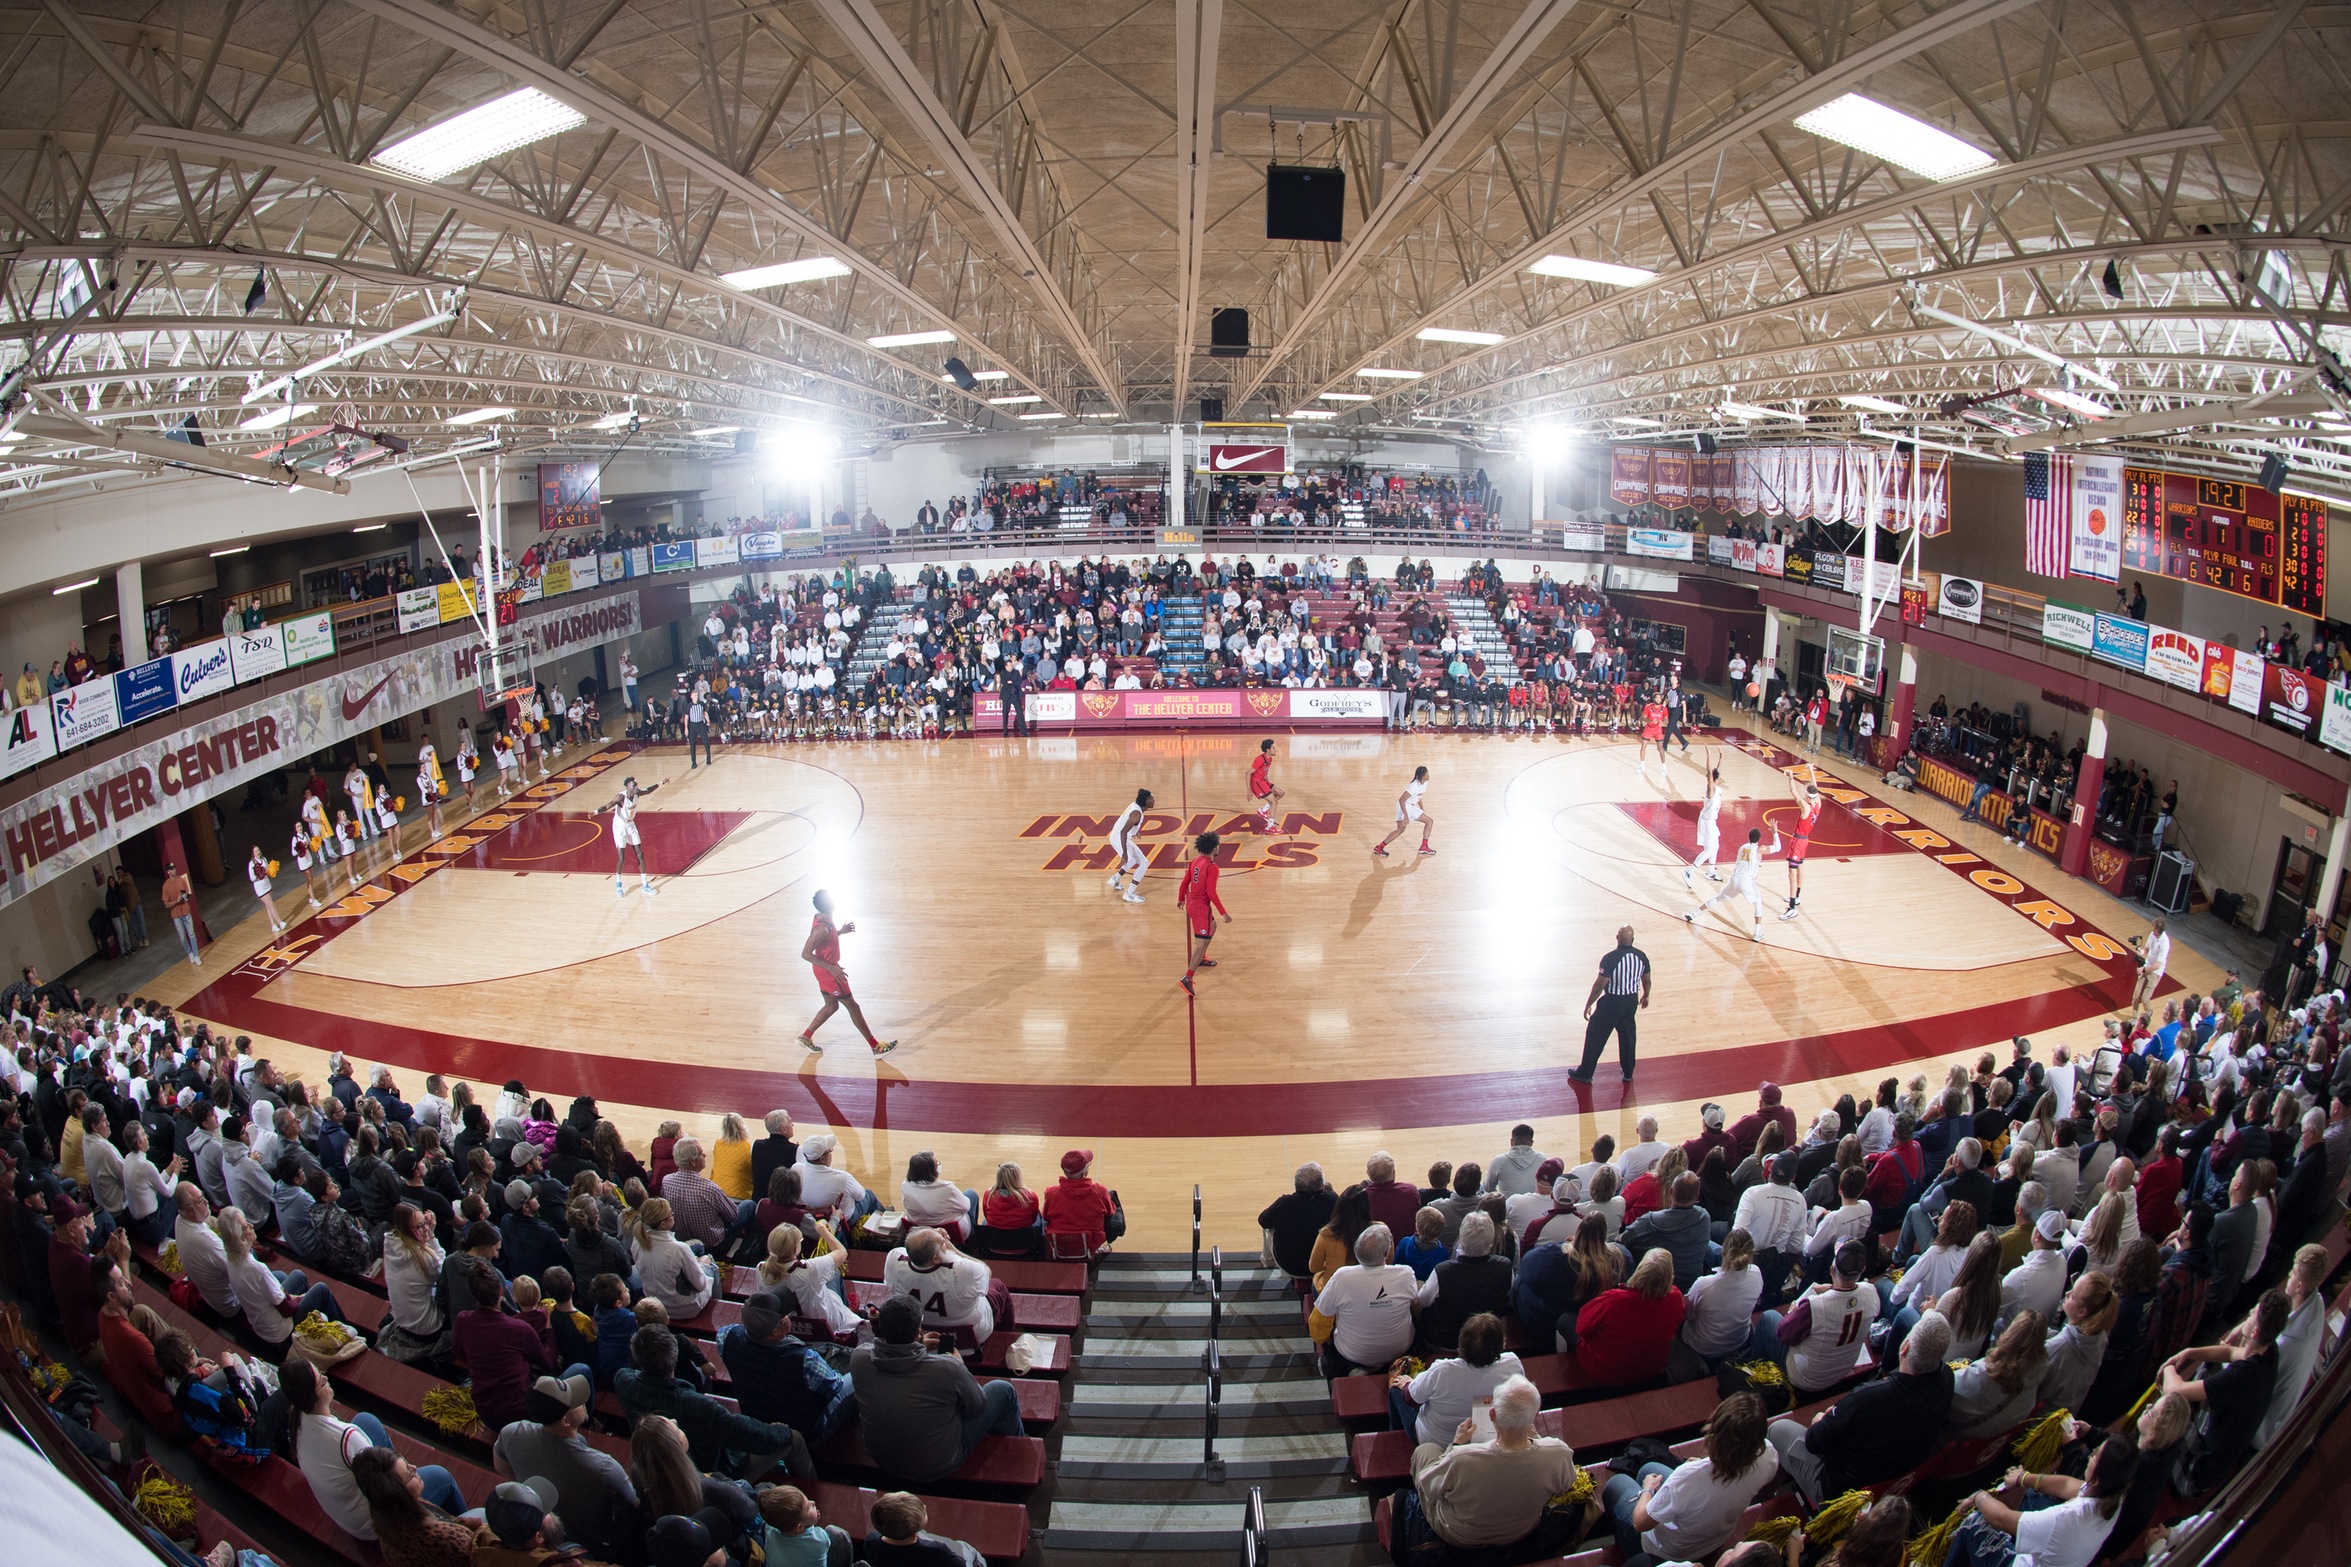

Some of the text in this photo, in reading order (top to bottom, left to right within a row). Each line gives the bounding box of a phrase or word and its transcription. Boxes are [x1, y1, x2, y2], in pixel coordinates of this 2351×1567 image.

[1614, 447, 1650, 457] INDIAN HILLS
[1654, 450, 1688, 459] INDIAN HILLS
[2085, 466, 2109, 479] NATIONAL
[2126, 471, 2161, 484] PLY FL PTS
[1614, 480, 1649, 494] CHAMPIONS
[1654, 483, 1688, 497] CHAMPIONS
[2077, 479, 2118, 494] INTERCOLLEGIATE
[2132, 483, 2161, 498] 3 0 0
[2205, 482, 2243, 507] 19:21
[553, 490, 559, 504] 2
[1620, 491, 1642, 499] 2021
[1658, 495, 1683, 503] 2022
[2088, 494, 2106, 506] RECORD
[2129, 498, 2161, 512] 11 0 0
[2168, 502, 2198, 516] WARRIORS
[2285, 495, 2325, 514] PLY FL PTS
[2126, 511, 2161, 527] 22 0 0
[2212, 515, 2230, 525] PERIOD
[2247, 516, 2275, 531] RAIDERS
[2301, 512, 2308, 526] 0
[2317, 515, 2324, 530] 0
[1164, 532, 1195, 542] Hills
[2126, 524, 2160, 542] 23 0 0
[2185, 518, 2194, 540] 2
[2291, 527, 2324, 547] 2 0 0
[749, 536, 776, 547] Vaughn
[2126, 539, 2160, 556] 24 0 0
[2170, 542, 2182, 554] FLS
[2264, 534, 2274, 558] 0
[1814, 552, 1835, 563] FLOOR
[2139, 555, 2146, 567] 0
[2204, 549, 2239, 567] PLYR FOUL
[2291, 543, 2324, 563] 3 0 0
[1532, 564, 1541, 574] D
[1821, 564, 1844, 576] CEILING
[2173, 557, 2181, 574] 0
[2190, 561, 2197, 579] 6
[2261, 562, 2274, 576] FLS
[2285, 558, 2323, 580] 30 0 0
[2206, 566, 2222, 585] 42
[2243, 574, 2251, 592] 6
[440, 586, 475, 601] Edward Jnes
[2284, 575, 2297, 589] 42
[2315, 583, 2323, 597] 0
[1950, 592, 1971, 602] FITNESS
[501, 604, 514, 623] 27
[1903, 602, 1918, 621] 27
[2046, 613, 2092, 633] RICHWELL
[2050, 622, 2065, 631] CARPET
[2069, 627, 2087, 635] CABINET
[299, 636, 311, 644] Quality
[454, 633, 515, 681] HOE
[541, 602, 633, 651] WARRIORS!
[2059, 631, 2075, 639] CENTER
[2099, 622, 2145, 646] SCHROEDER
[241, 636, 273, 654] TSD
[288, 646, 302, 654] Trusted
[2151, 633, 2200, 664] REED
[2207, 646, 2222, 659] olé
[136, 662, 161, 675] BELLEVUE
[137, 670, 156, 679] UNIVERSITY
[180, 647, 227, 694] Culver's
[2235, 664, 2261, 678] taco john's
[79, 689, 111, 705] RIVER COMMUNITY
[132, 685, 163, 701] Accelerate.
[1163, 695, 1199, 703] WELCOME TO
[2294, 690, 2304, 706] C
[1133, 703, 1232, 715] THE HELLYER CENTER
[1309, 699, 1372, 707] GODFREY'S
[8, 709, 38, 750] AL
[66, 714, 110, 739] 641-684-3202
[5, 715, 280, 876] HELLYER CENTER
[1018, 812, 1344, 838] INDIAN
[1979, 792, 2061, 854] ATHTICS
[315, 751, 632, 919] WARRIORS
[1042, 841, 1321, 871] HILLS
[1779, 763, 2128, 961] WARRIORS
[1193, 867, 1200, 883] 2
[1835, 1310, 1864, 1348] 11
